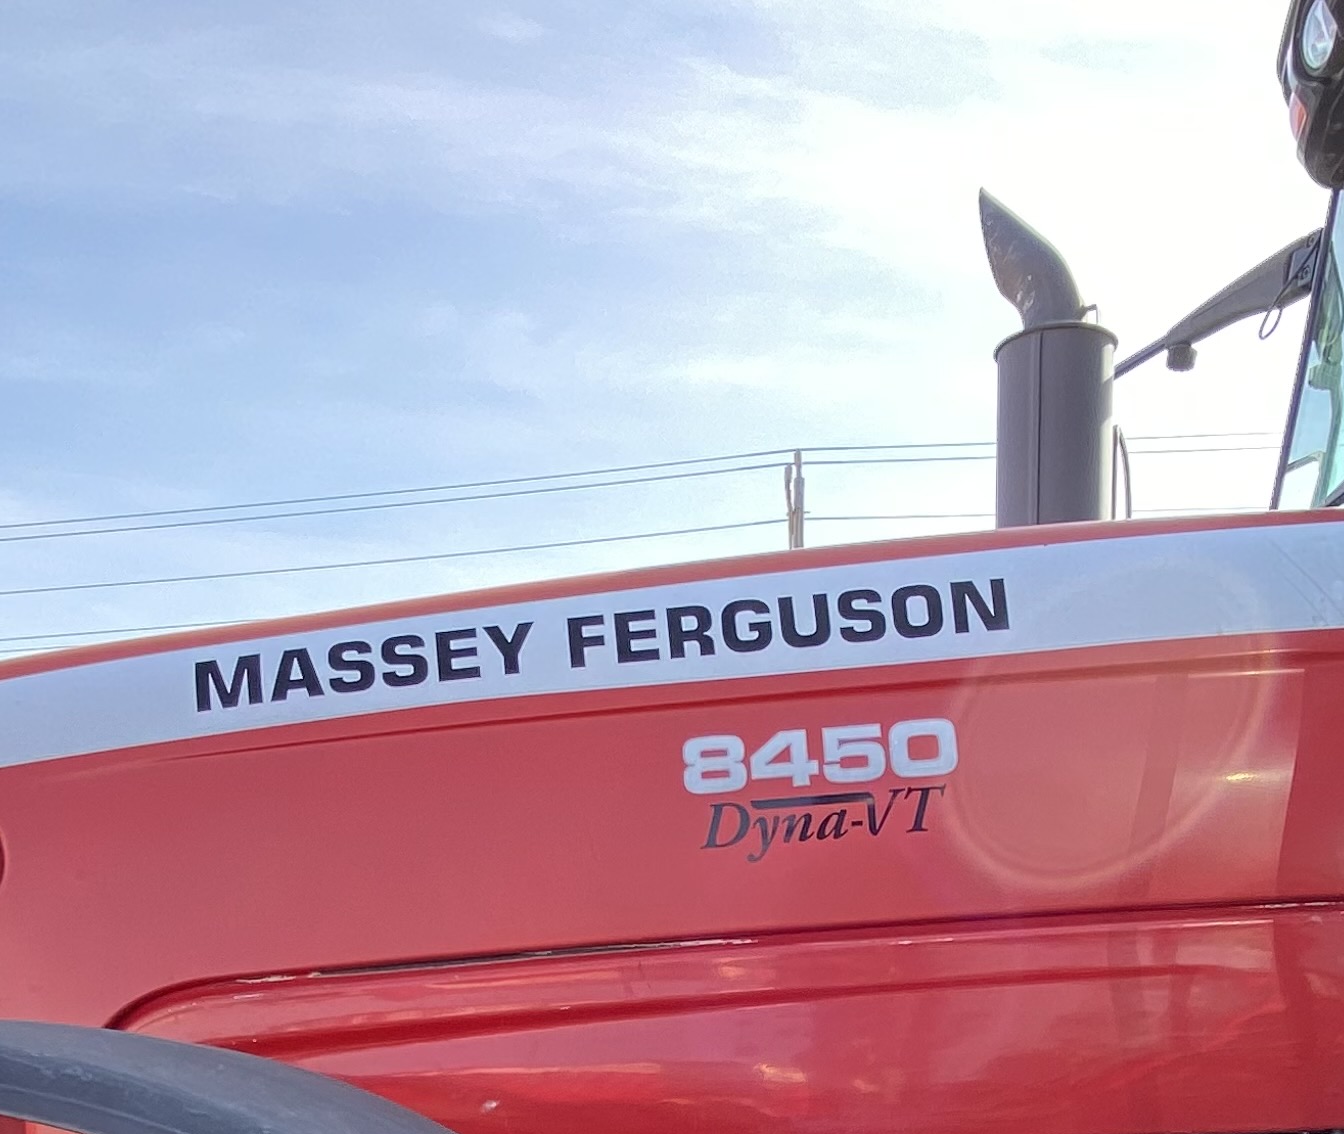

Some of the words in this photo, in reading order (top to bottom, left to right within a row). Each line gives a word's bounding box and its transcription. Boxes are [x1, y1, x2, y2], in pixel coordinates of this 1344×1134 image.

[194, 620, 534, 713] MASSEY
[567, 577, 1011, 669] FERGUSON
[682, 718, 959, 795] 8450
[700, 784, 947, 863] Dyna-VT
